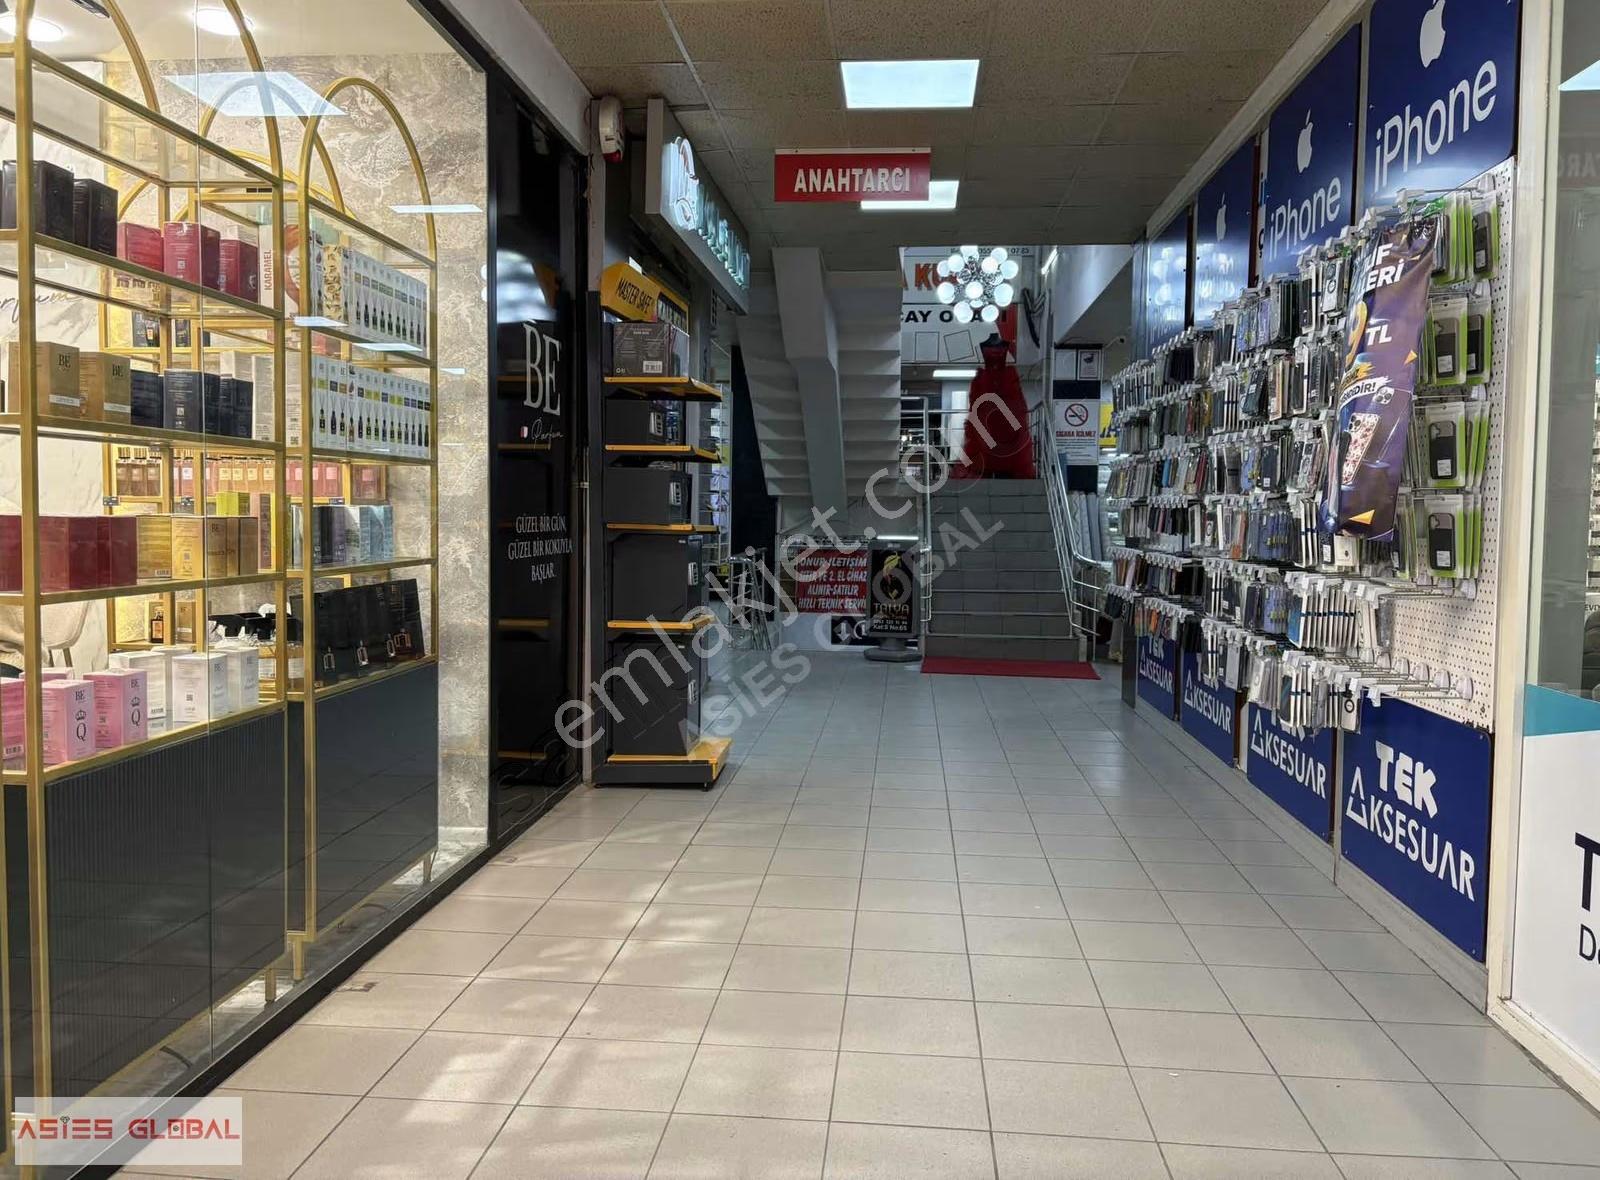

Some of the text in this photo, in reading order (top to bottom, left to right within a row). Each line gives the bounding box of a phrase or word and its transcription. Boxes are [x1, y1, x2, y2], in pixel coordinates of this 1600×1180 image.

[1374, 60, 1497, 193] iPhone
[793, 167, 911, 193] ANAHTARCI
[1269, 176, 1341, 262] iPhone
[264, 249, 272, 291] KARAMEL
[616, 278, 653, 314] MASTER SAFE
[1366, 323, 1393, 346] TL
[59, 353, 71, 368] BE
[112, 363, 123, 377] BE
[523, 321, 561, 416] BE
[515, 513, 539, 533] GÜZEL
[539, 512, 551, 532] BİR
[508, 539, 532, 560] GÜZEL
[532, 537, 544, 557] BİR
[130, 678, 140, 689] BE
[1139, 647, 1173, 695] AKSESUAR
[75, 689, 86, 701] BE
[1183, 669, 1232, 735] AKSESUAR
[76, 722, 87, 742] Q
[131, 708, 141, 727] Q
[1250, 708, 1327, 800] AKSESUAR
[1376, 739, 1437, 818] TEK
[1345, 766, 1475, 902] AKSESUAR
[1579, 923, 1600, 965] D
